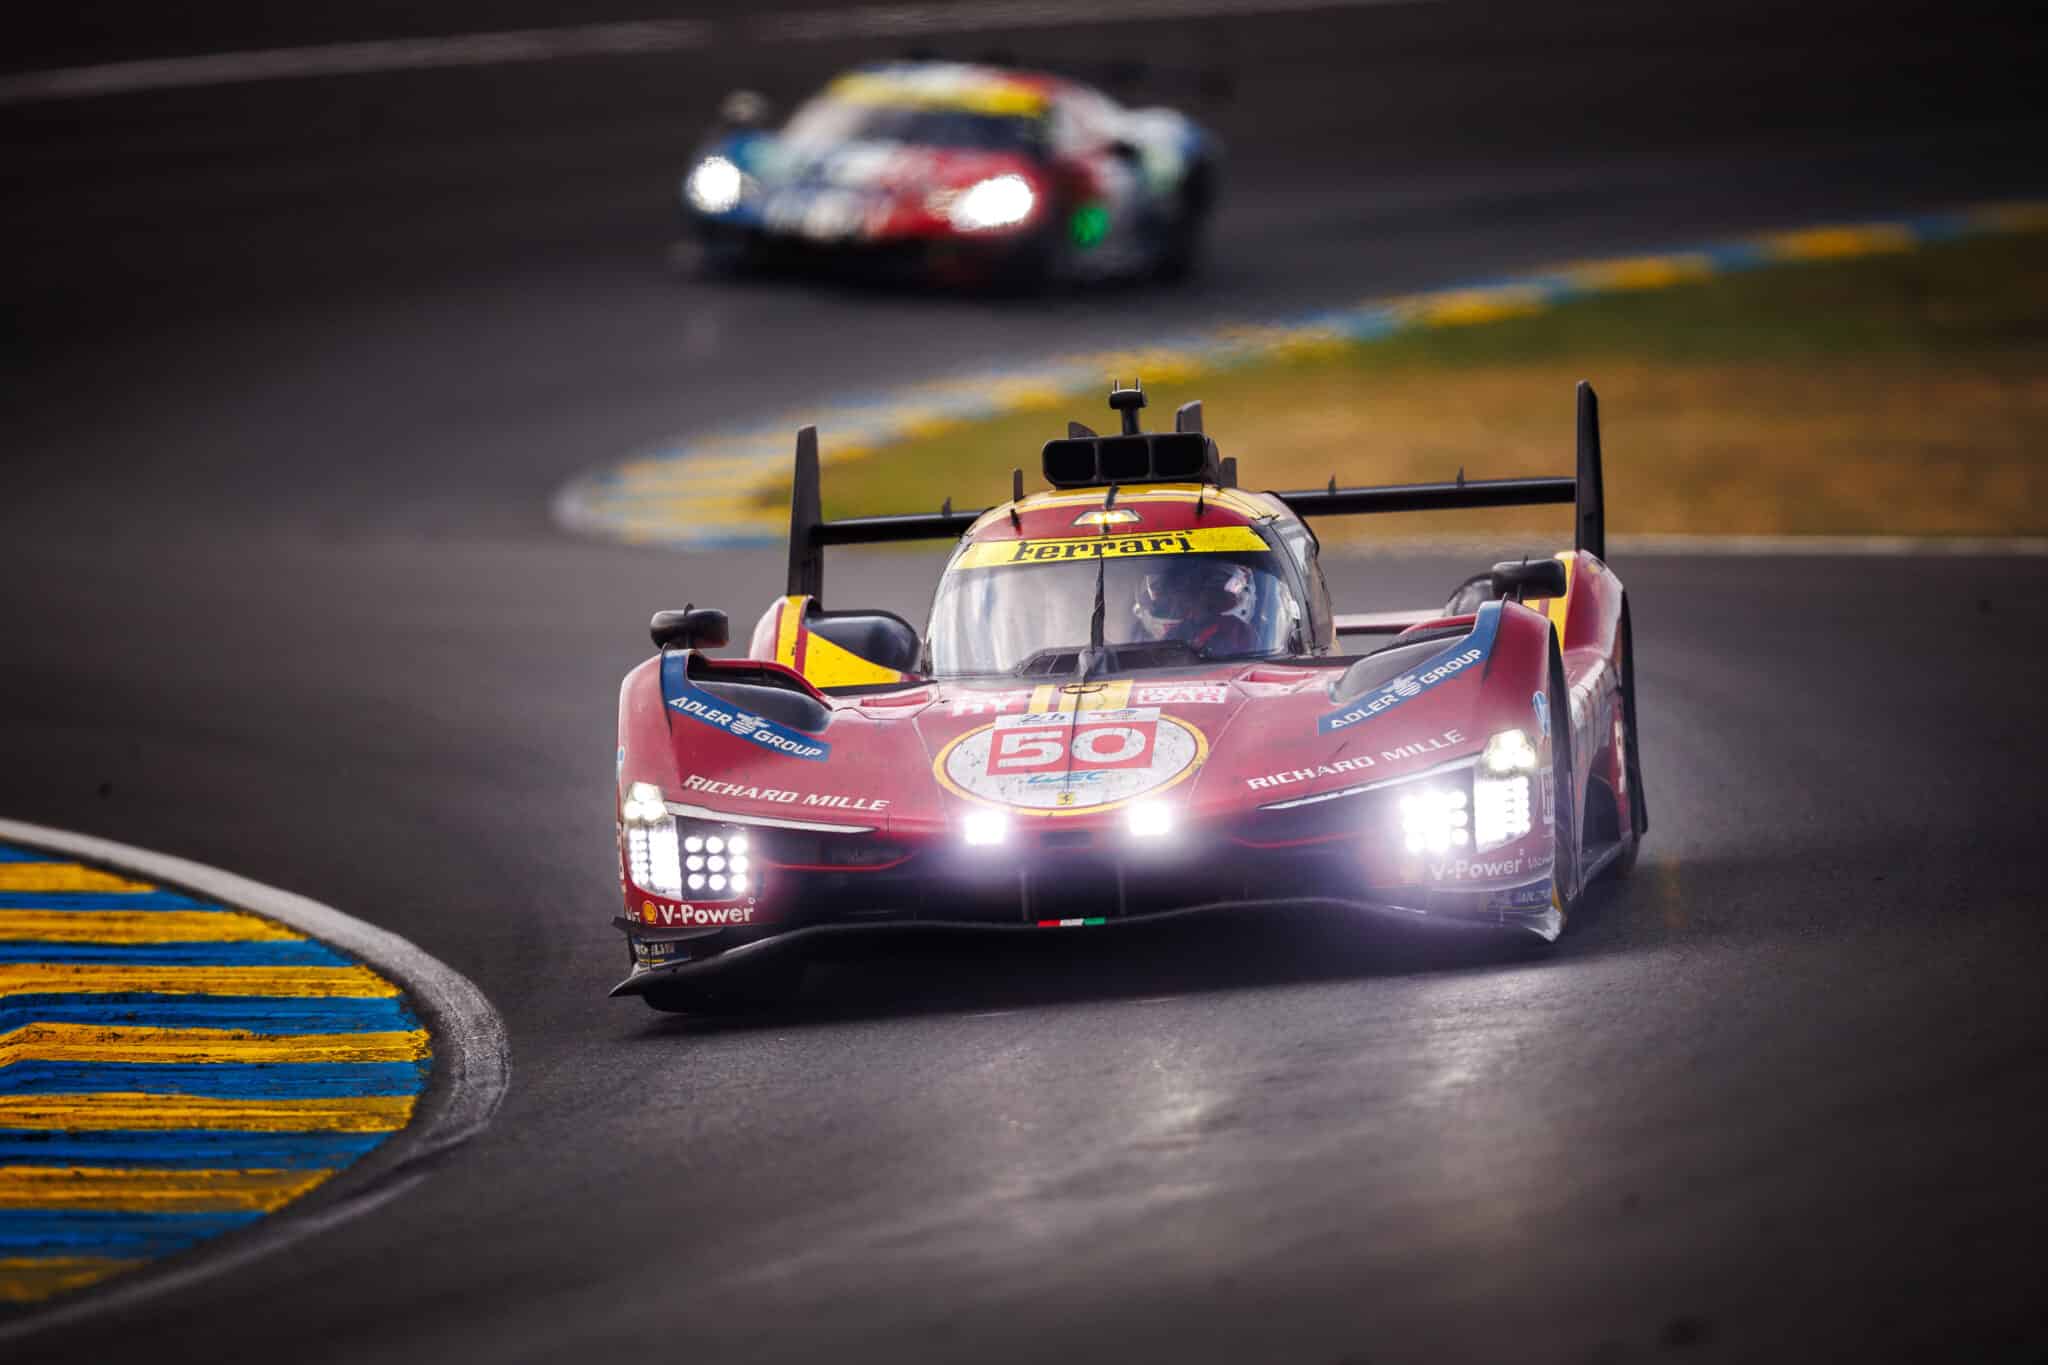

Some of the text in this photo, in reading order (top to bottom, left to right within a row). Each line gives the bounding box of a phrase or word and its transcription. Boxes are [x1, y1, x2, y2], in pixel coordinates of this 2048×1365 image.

[1008, 531, 1195, 562] Ferrari
[1330, 648, 1482, 729] ADLER GROUP
[668, 695, 822, 759] ADLER GROUP
[997, 726, 1147, 770] 50
[1247, 728, 1467, 790] RICHARD MILLE
[684, 773, 890, 812] RICHARD MILLE
[1429, 858, 1523, 881] V-Power
[659, 904, 754, 926] V-Power
